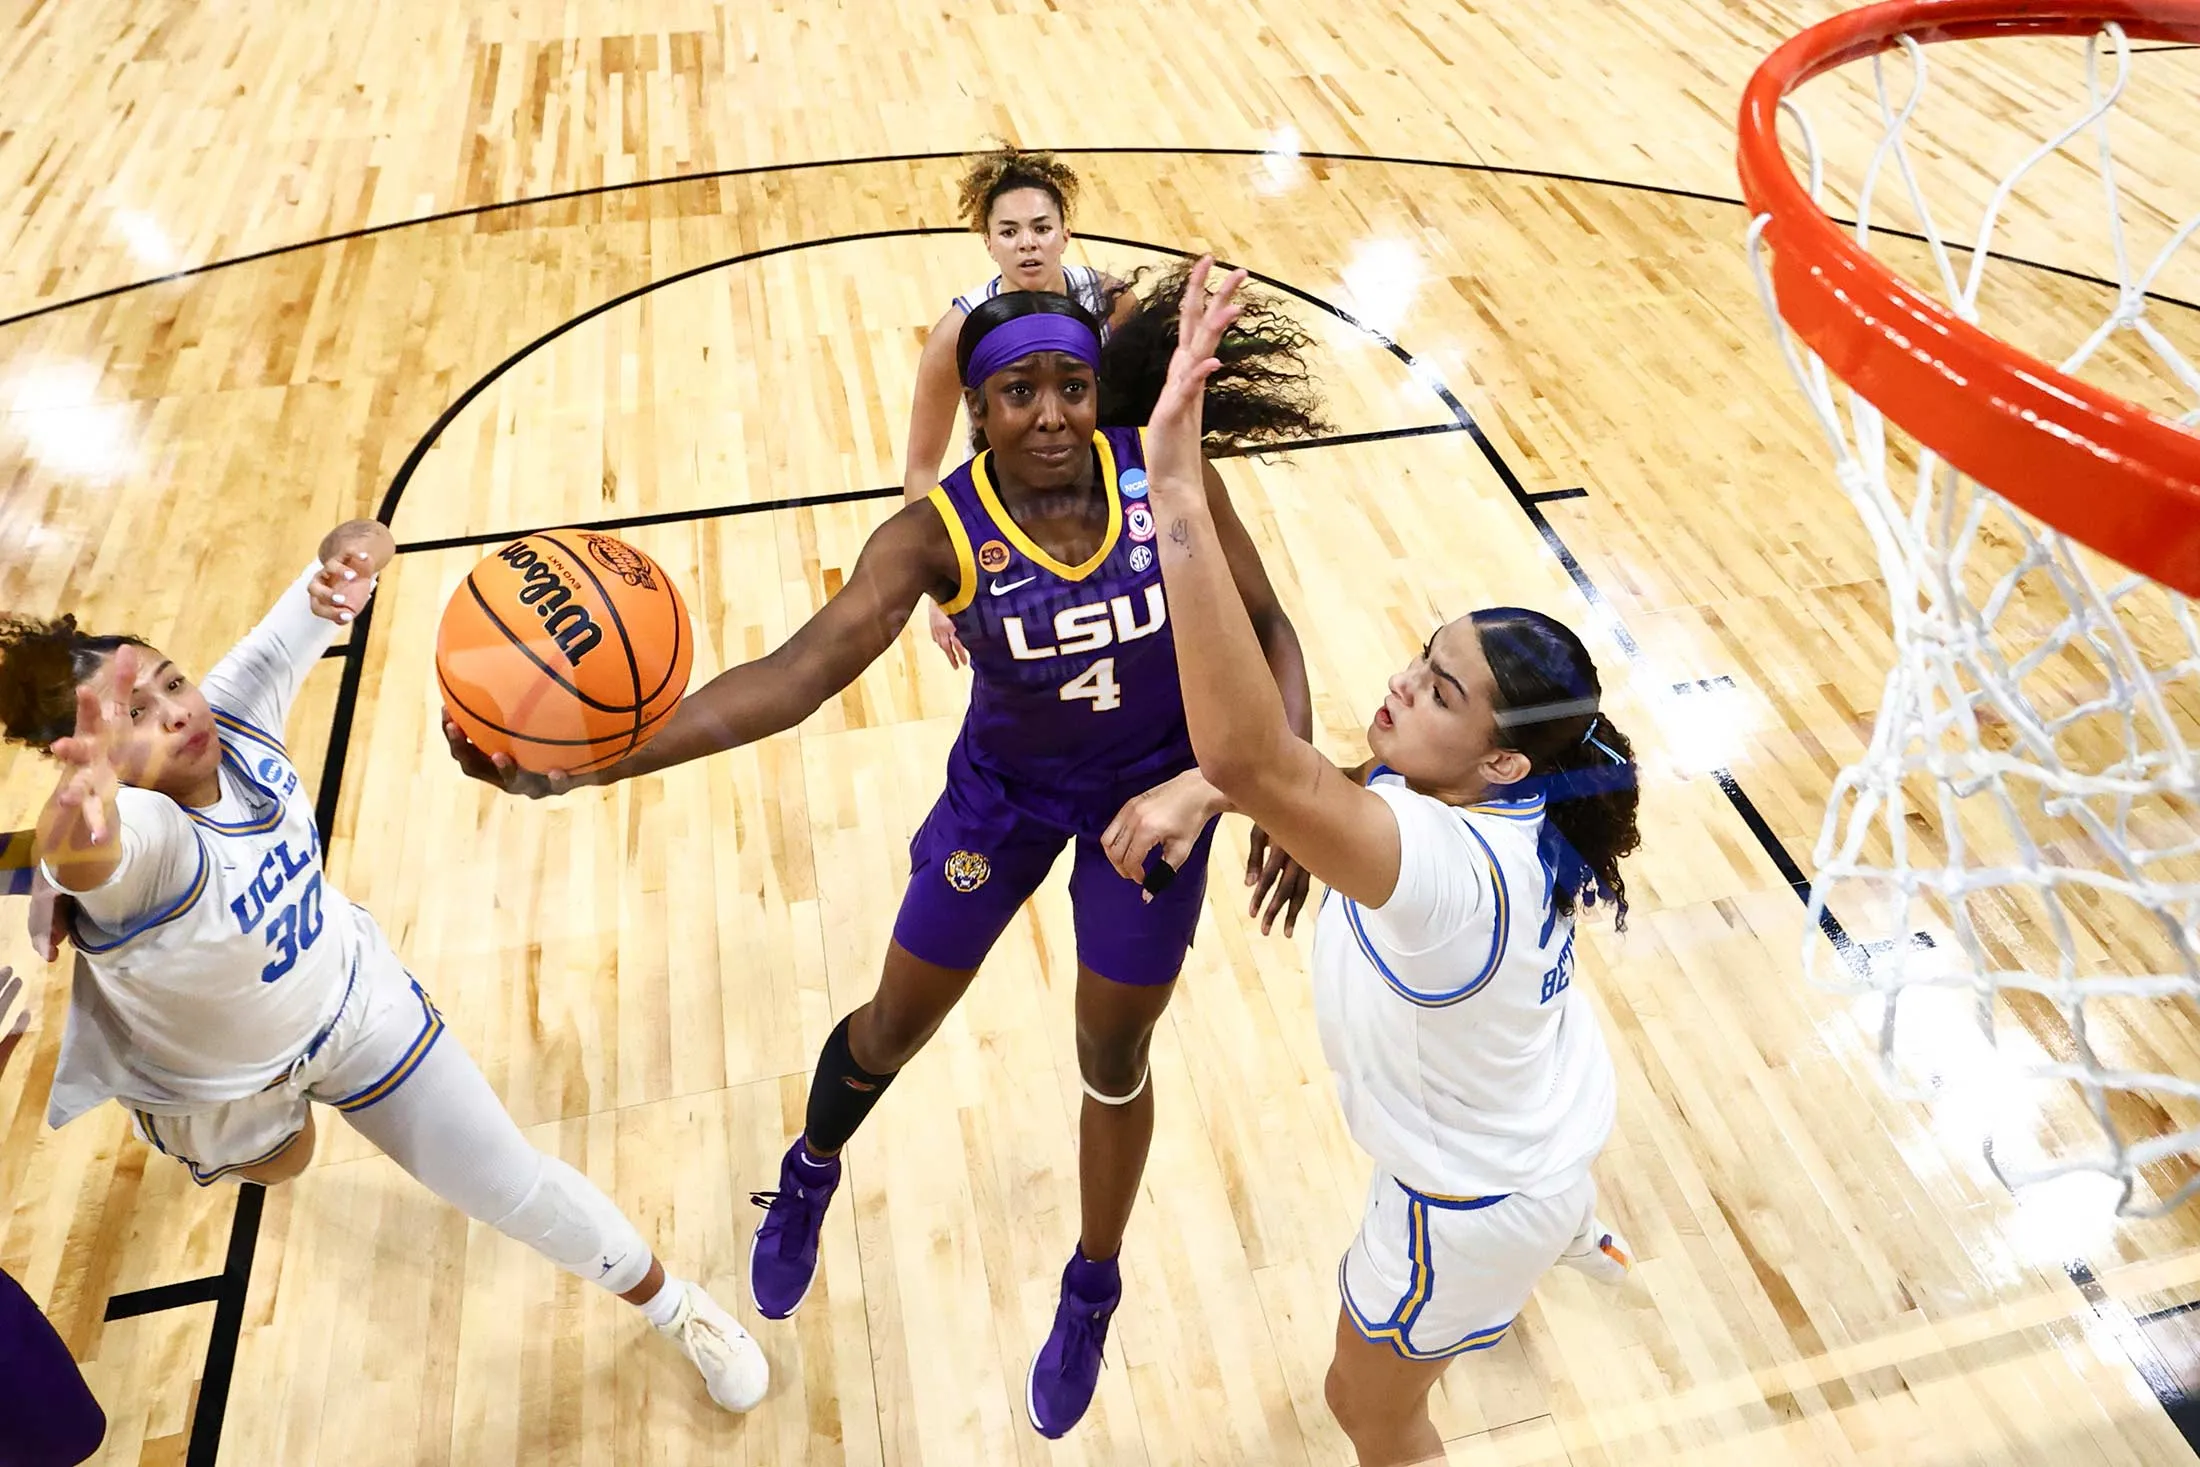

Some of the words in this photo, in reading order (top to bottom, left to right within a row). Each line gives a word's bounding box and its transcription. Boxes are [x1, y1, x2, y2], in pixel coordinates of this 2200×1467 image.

[546, 555, 564, 571] NXT
[562, 571, 582, 590] EVO
[1131, 546, 1151, 571] SEC
[498, 541, 602, 667] Wilson
[1002, 582, 1167, 660] LSU
[1058, 656, 1121, 712] 4
[261, 870, 323, 983] 30
